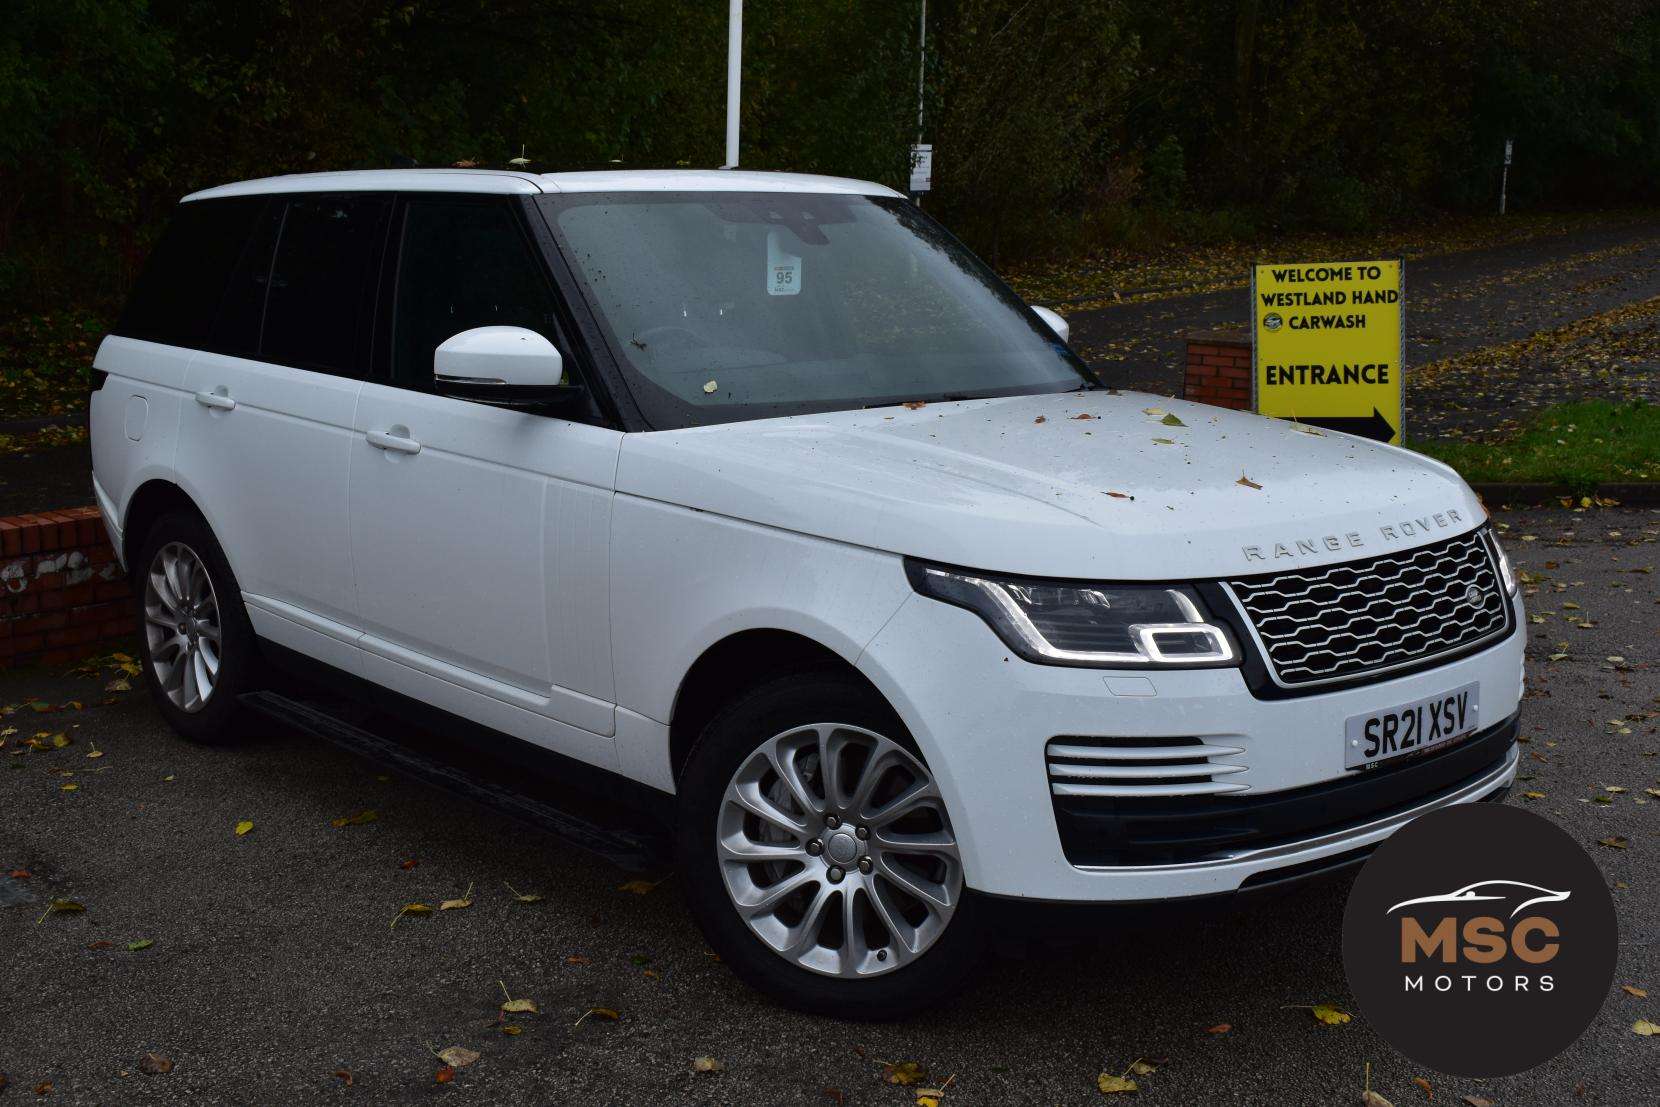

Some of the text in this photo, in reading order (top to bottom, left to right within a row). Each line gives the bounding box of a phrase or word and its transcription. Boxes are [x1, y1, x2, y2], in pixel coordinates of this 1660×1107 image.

[776, 271, 793, 284] 95
[1272, 266, 1381, 282] WELCOME TO
[1261, 290, 1399, 307] WESTLAND HAND
[1289, 315, 1366, 330] CARWASH
[1266, 364, 1389, 385] ENTRANCE
[1241, 508, 1463, 562] RANGE ROVER
[1364, 691, 1468, 758] SR21 XSV
